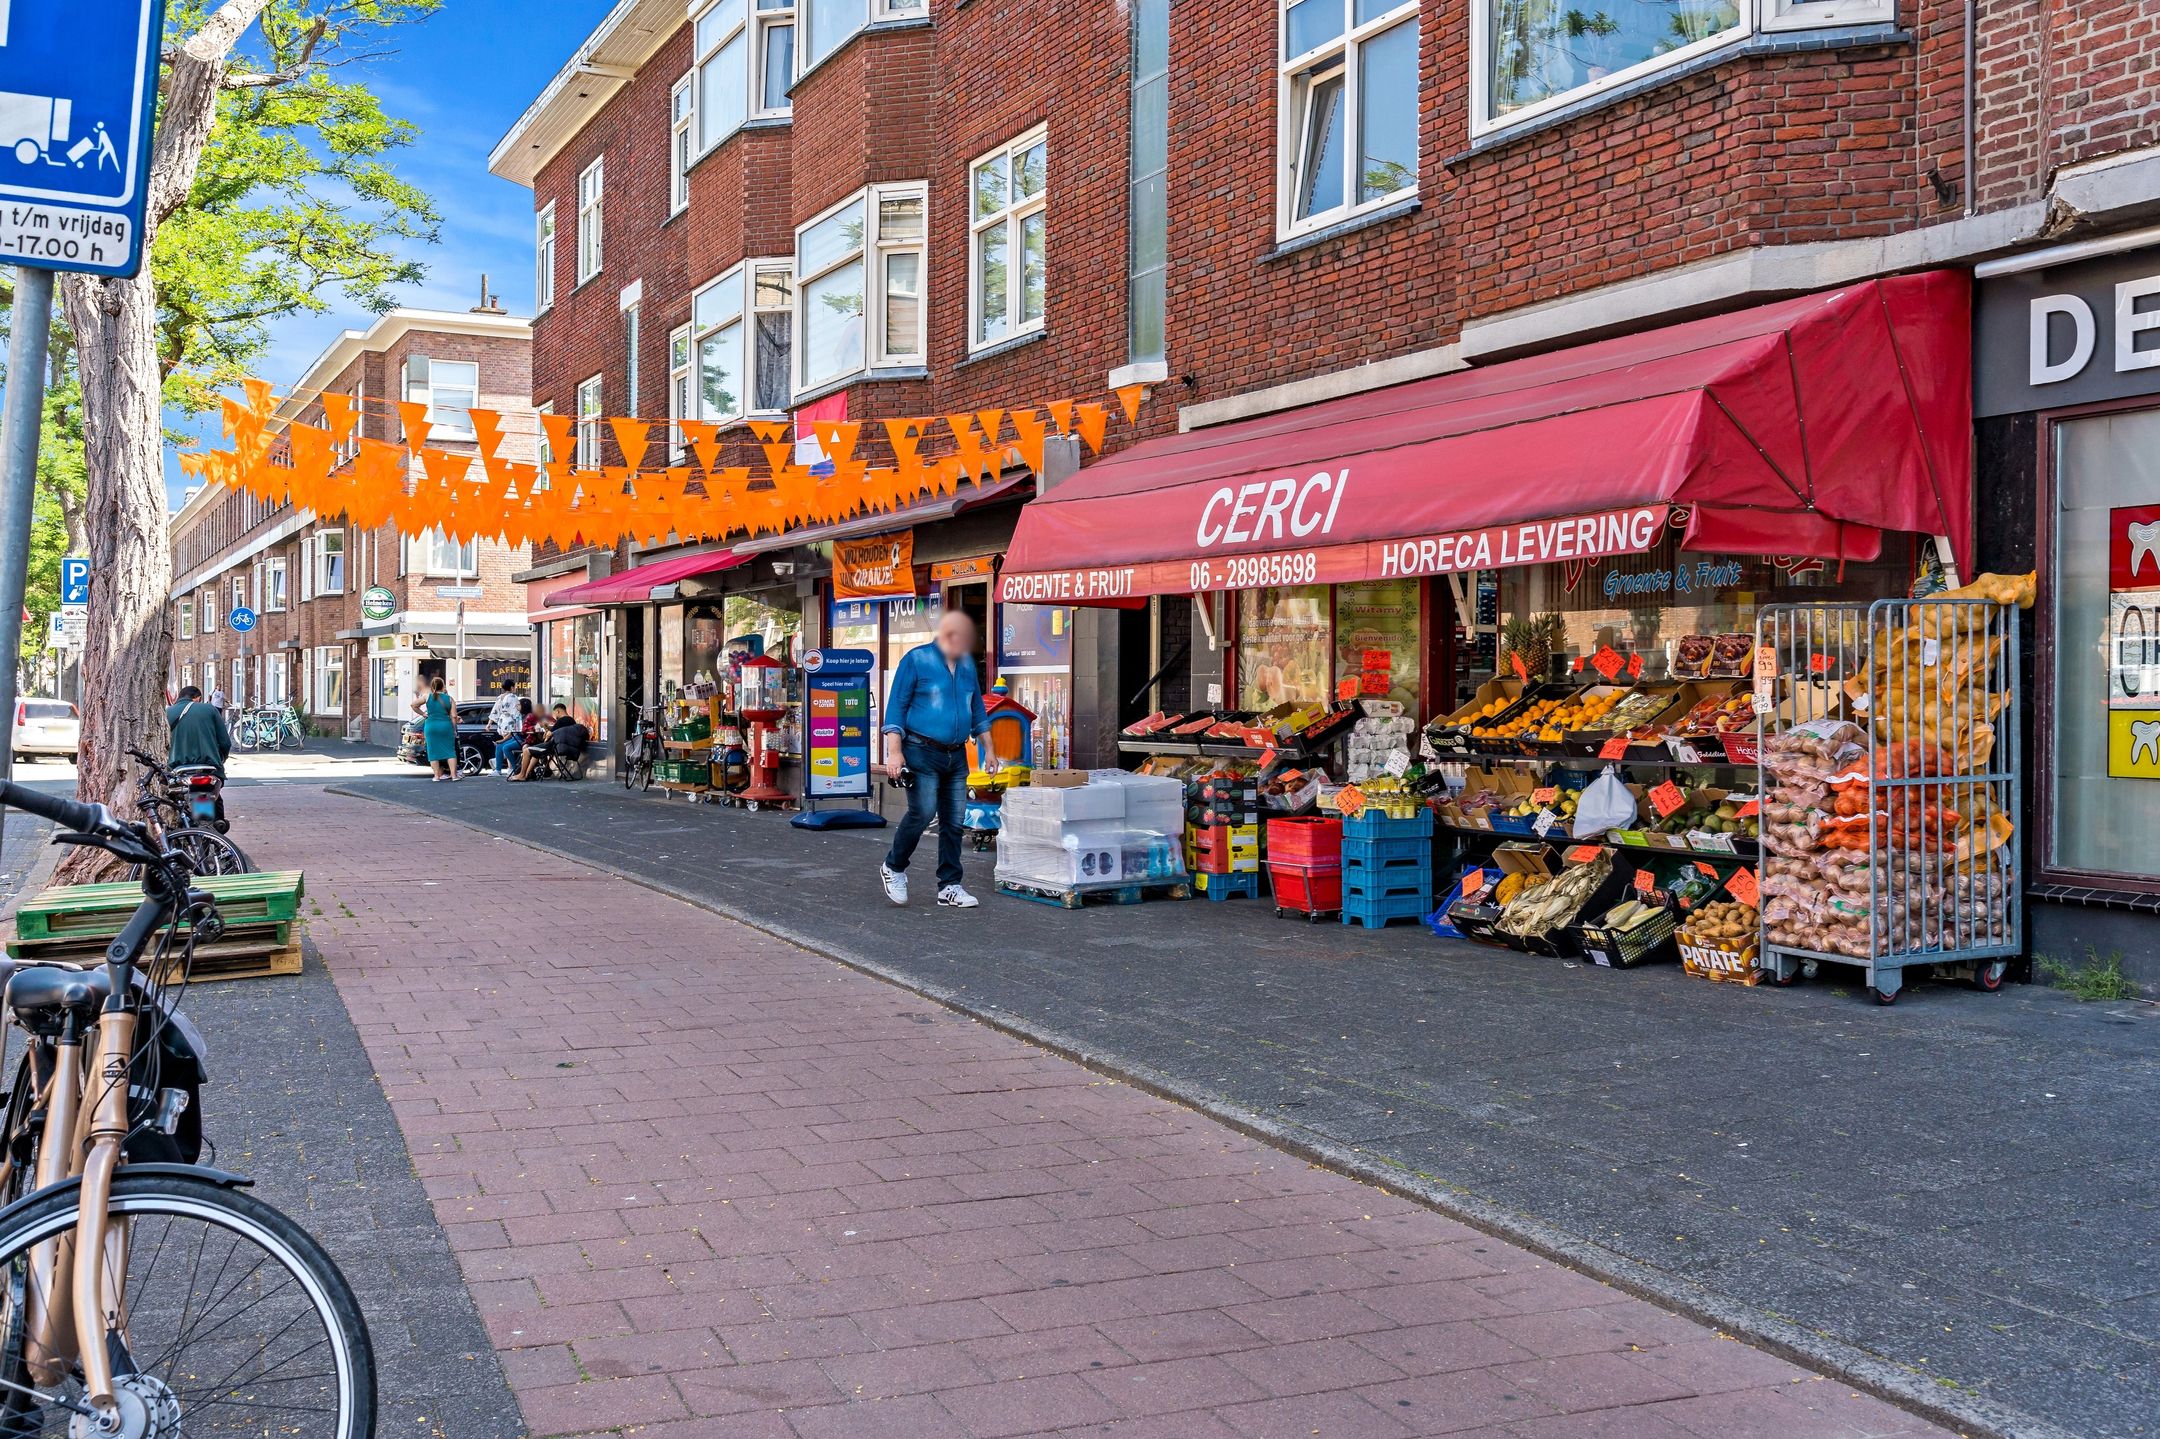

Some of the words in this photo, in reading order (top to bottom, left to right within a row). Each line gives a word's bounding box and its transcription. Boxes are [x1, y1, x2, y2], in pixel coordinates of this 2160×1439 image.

[12, 207, 49, 229] t/m
[59, 214, 125, 243] vrijdag
[0, 234, 79, 258] -17.00
[90, 242, 103, 262] h
[2029, 275, 2160, 386] DE
[1196, 468, 1350, 548] CERCI
[858, 544, 888, 564] HOUDEN
[1381, 532, 1492, 577] HORECA
[1499, 510, 1654, 565] LEVERING
[69, 562, 87, 586] P
[853, 565, 894, 588] ORANJE!
[951, 561, 977, 576] HOLLAND
[1190, 561, 1210, 590] 06
[1225, 552, 1316, 588] 28985698
[1603, 569, 1672, 602] Groente
[1675, 563, 1691, 593] &
[1695, 560, 1743, 587] Fruit
[1002, 572, 1071, 600] GROENTE
[1074, 572, 1085, 598] &
[1089, 568, 1135, 597] FRUIT
[889, 599, 915, 622] Lyca
[1355, 606, 1402, 615] Witamy
[845, 698, 859, 706] TOTO
[1679, 943, 1744, 973] PATATE
